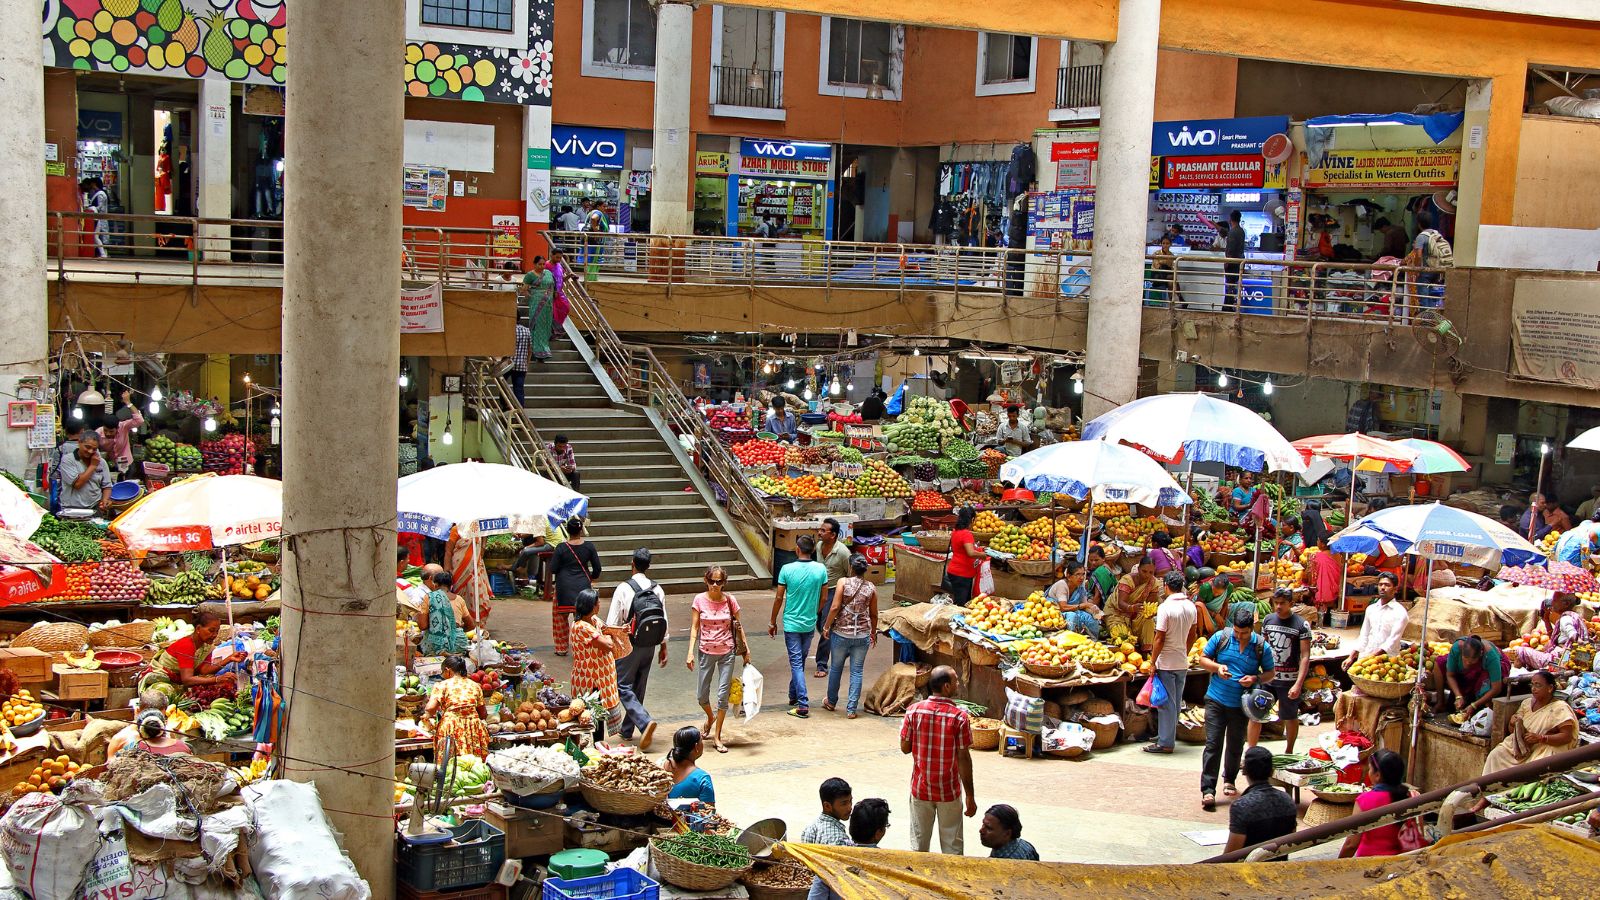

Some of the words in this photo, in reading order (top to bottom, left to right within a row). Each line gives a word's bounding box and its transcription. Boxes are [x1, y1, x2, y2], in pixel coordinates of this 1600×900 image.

[78, 119, 112, 131] vo
[1168, 125, 1216, 147] vivo
[552, 134, 617, 158] vivo
[753, 141, 797, 157] vivo
[698, 154, 719, 166] ARUN
[741, 157, 767, 169] AZHAR
[770, 159, 799, 171] MOBILE
[801, 160, 828, 173] STORE
[1175, 162, 1218, 172] PRASHANT
[1220, 161, 1261, 171] CELLULAR
[1355, 158, 1375, 169] LADIES
[1375, 156, 1413, 168] COLLECTIONS
[1419, 155, 1453, 167] TAILORING
[1219, 172, 1253, 180] ACCESSORIES
[1323, 169, 1363, 183] Specialist
[1365, 169, 1374, 179] in
[1376, 169, 1411, 179] Western
[1413, 168, 1446, 179] Outfits
[1225, 192, 1261, 203] SAMSUNG
[419, 302, 438, 310] ALLOWED
[235, 523, 262, 535] airtel
[266, 521, 282, 533] 3G
[480, 518, 509, 531] IIFL
[152, 532, 182, 545] airtel
[186, 532, 200, 544] 3G
[18, 578, 40, 596] airtel
